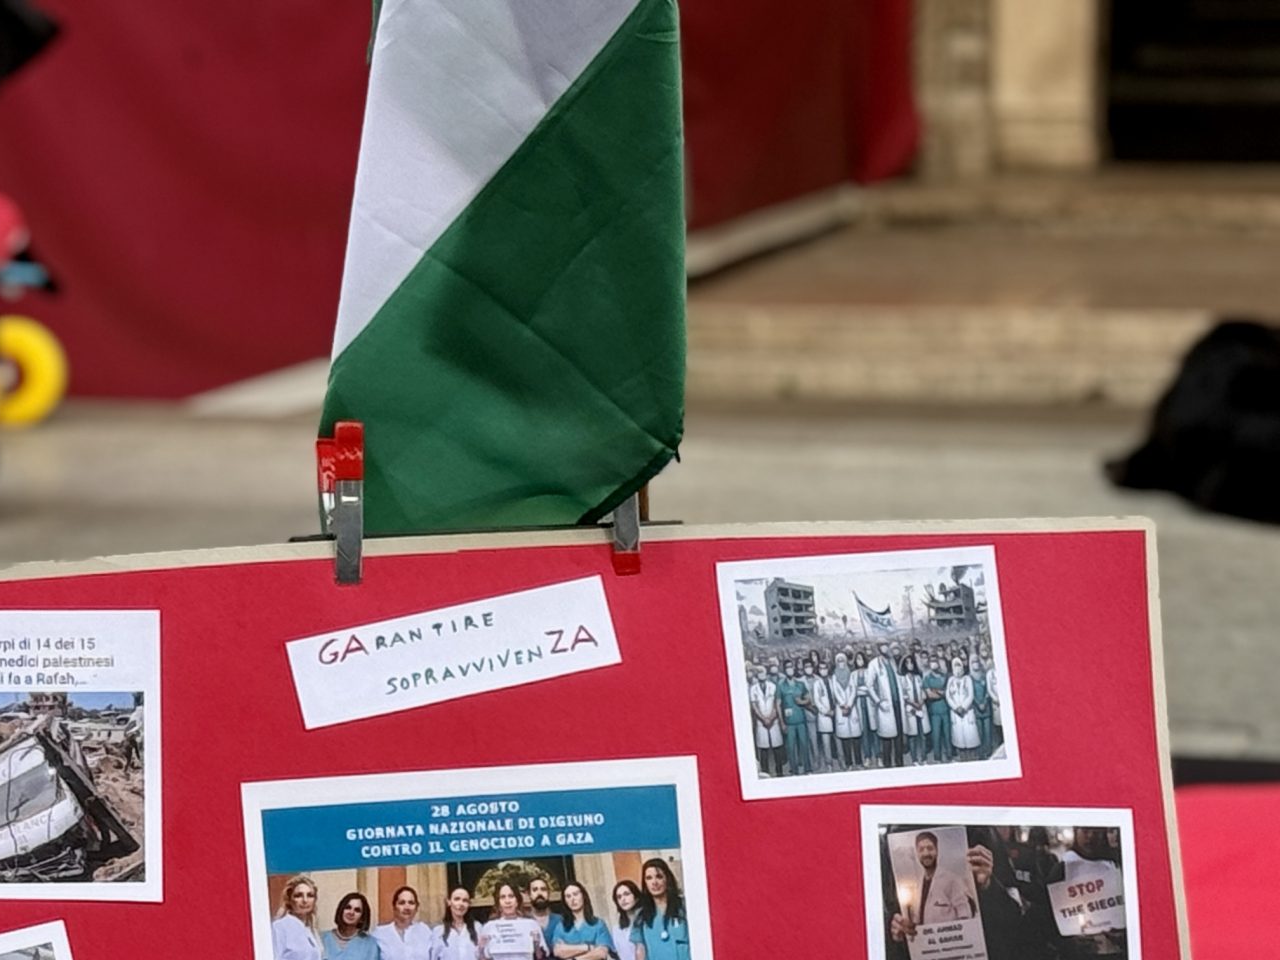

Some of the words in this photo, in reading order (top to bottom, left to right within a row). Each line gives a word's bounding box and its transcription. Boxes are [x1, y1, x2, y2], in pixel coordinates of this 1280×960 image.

[19, 637, 31, 650] di
[37, 637, 51, 650] 14
[55, 637, 75, 650] dei
[80, 637, 96, 650] 15
[318, 612, 495, 664] GARANTIRE
[42, 655, 115, 668] palestinesi
[385, 624, 598, 695] SOPRAVVIVENZA
[8, 671, 21, 685] fa
[24, 675, 33, 685] a
[431, 805, 450, 818] 28
[456, 801, 521, 816] AGOSTO
[346, 823, 425, 841] GIORNATA
[429, 818, 514, 836] NAZIONALE
[518, 817, 536, 831] DI
[539, 812, 606, 829] DIGIUNO
[360, 843, 422, 859] CONTRO
[428, 840, 445, 854] IL
[449, 835, 535, 853] GENOCIDIO
[540, 834, 552, 847] A
[556, 831, 595, 846] GAZA
[1067, 879, 1104, 898] STOP
[1061, 904, 1086, 919] THE
[1087, 895, 1125, 913] SIEGE
